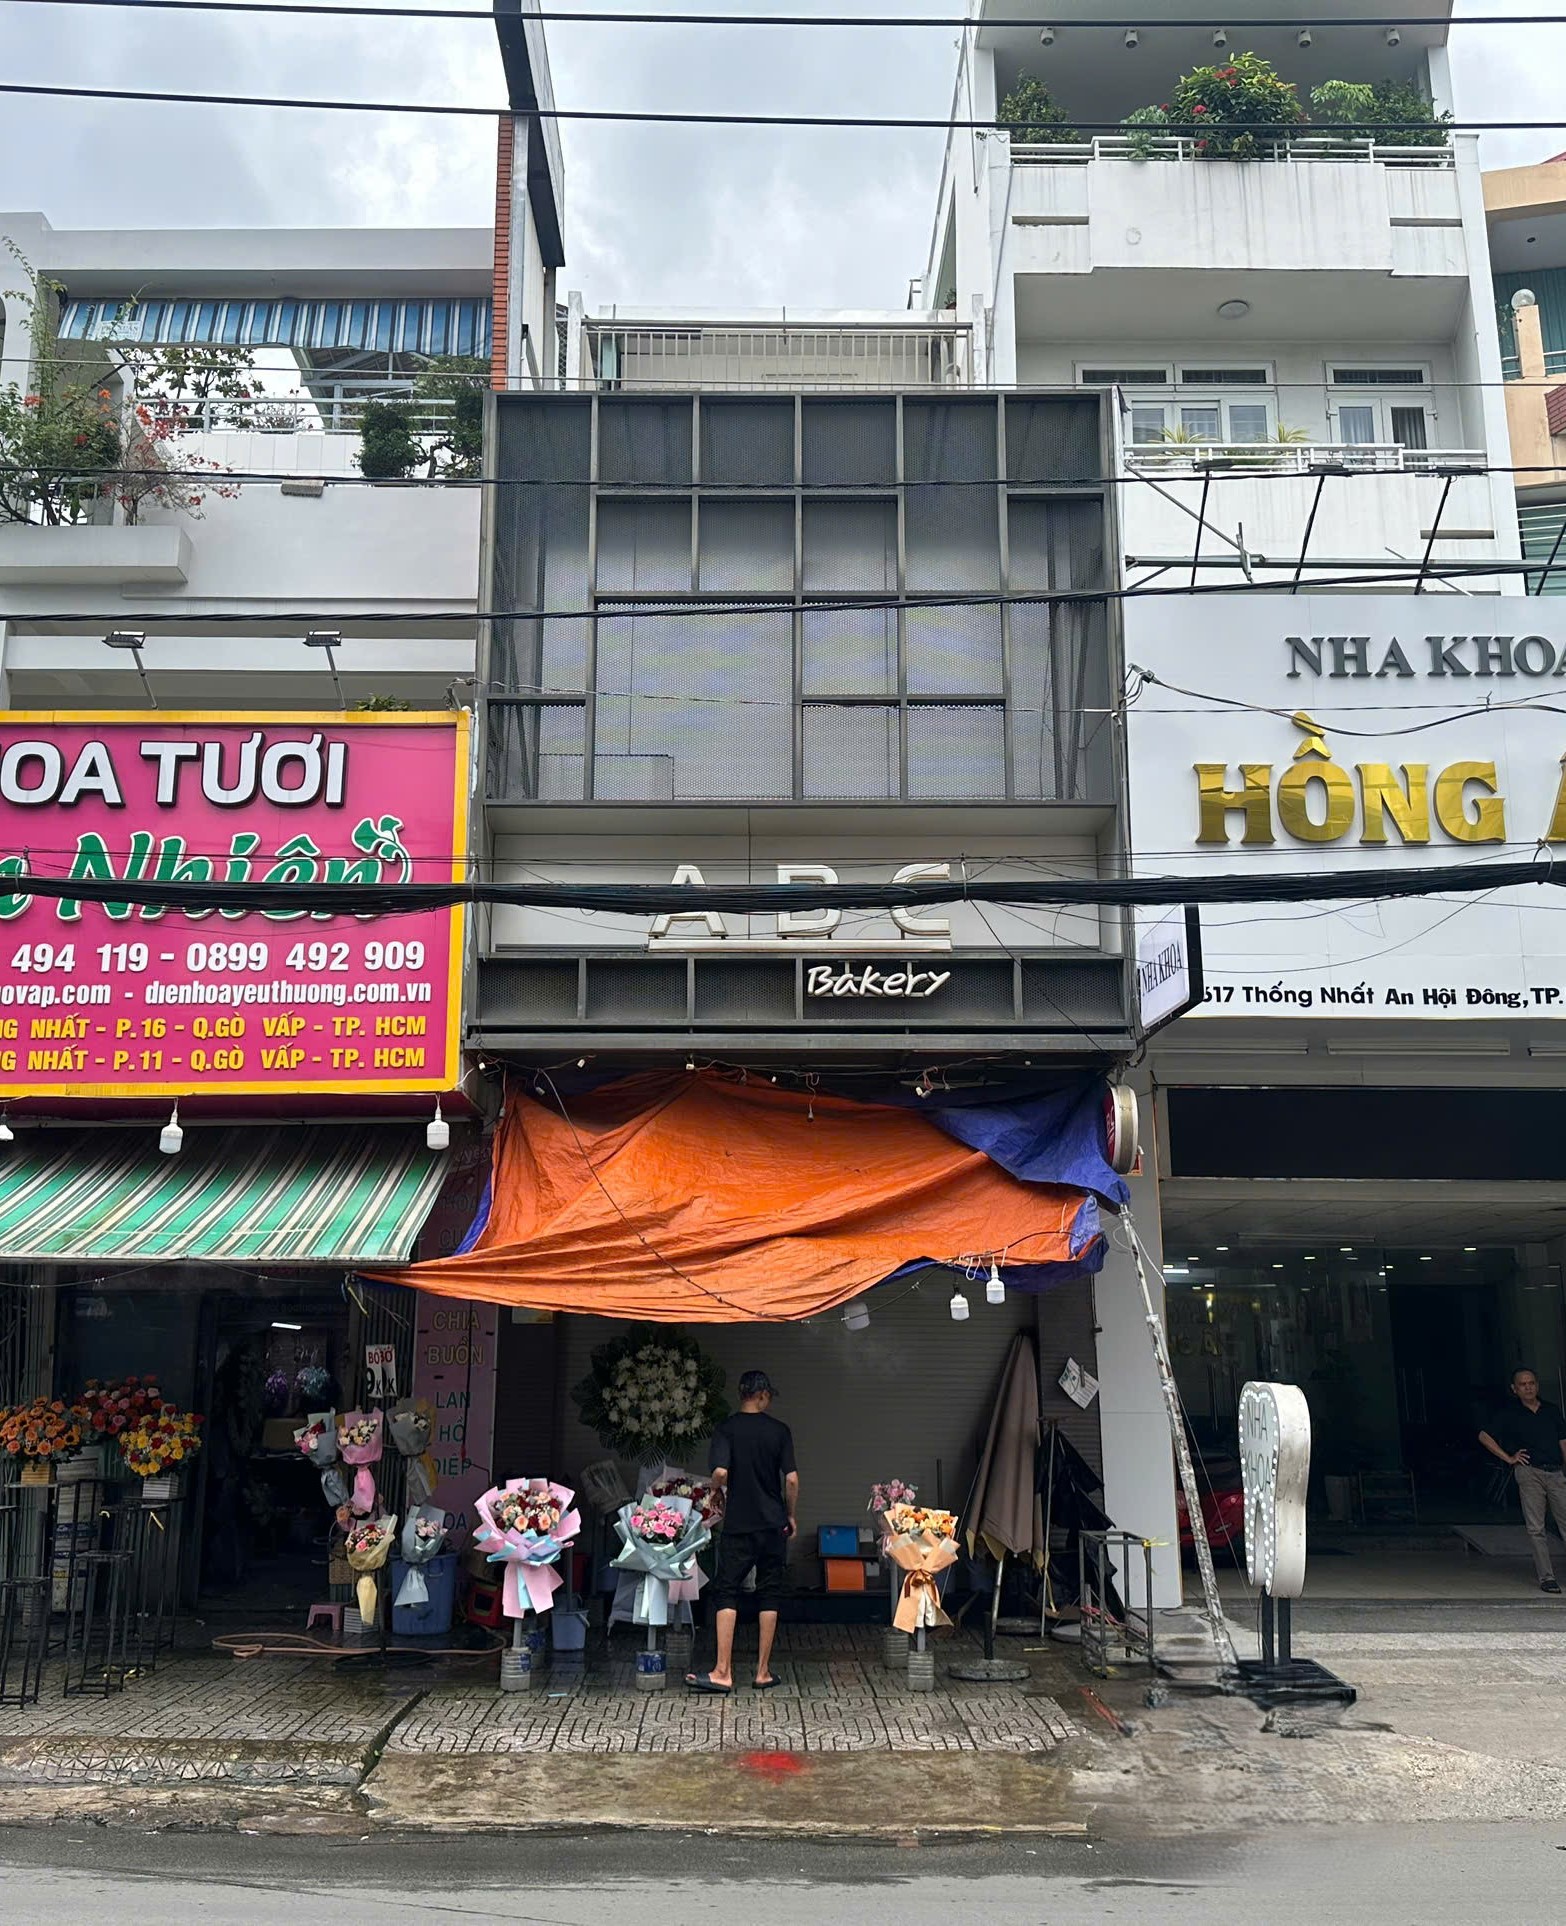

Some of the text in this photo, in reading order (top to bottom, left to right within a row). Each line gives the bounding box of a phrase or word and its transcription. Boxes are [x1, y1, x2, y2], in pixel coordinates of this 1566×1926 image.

[1285, 635, 1566, 679] NHA KHO
[0, 732, 347, 808] OA TƯƠI
[1192, 711, 1508, 844] HỒNG
[11, 942, 76, 973] 494
[96, 942, 149, 973] 119
[186, 941, 269, 972] 0899
[285, 942, 350, 972] 492
[364, 940, 425, 971] 909
[1141, 939, 1183, 996] NHA KHOA
[0, 983, 111, 1008] ovap.com
[807, 965, 951, 997] Bakery
[1242, 980, 1313, 1008] Thống
[1320, 982, 1374, 1005] Nhất
[1385, 988, 1414, 1005] An
[1422, 987, 1457, 1009] Hội
[30, 1012, 91, 1039] NHẤT
[192, 1011, 246, 1040] Q.GÒ
[262, 1010, 306, 1037] VẤP
[331, 1016, 366, 1037] TP.
[375, 1016, 427, 1037] HCM
[27, 1043, 89, 1071] NHẤT
[190, 1043, 245, 1072] Q.GÒ
[260, 1041, 306, 1070] VẤP
[330, 1048, 366, 1069] TP.
[373, 1048, 425, 1069] HCM
[433, 1311, 480, 1330] CHIA
[427, 1336, 485, 1365] BUỒN
[436, 1391, 471, 1409] LAN
[439, 1416, 465, 1442] HỒ
[1247, 1399, 1269, 1441] NHA
